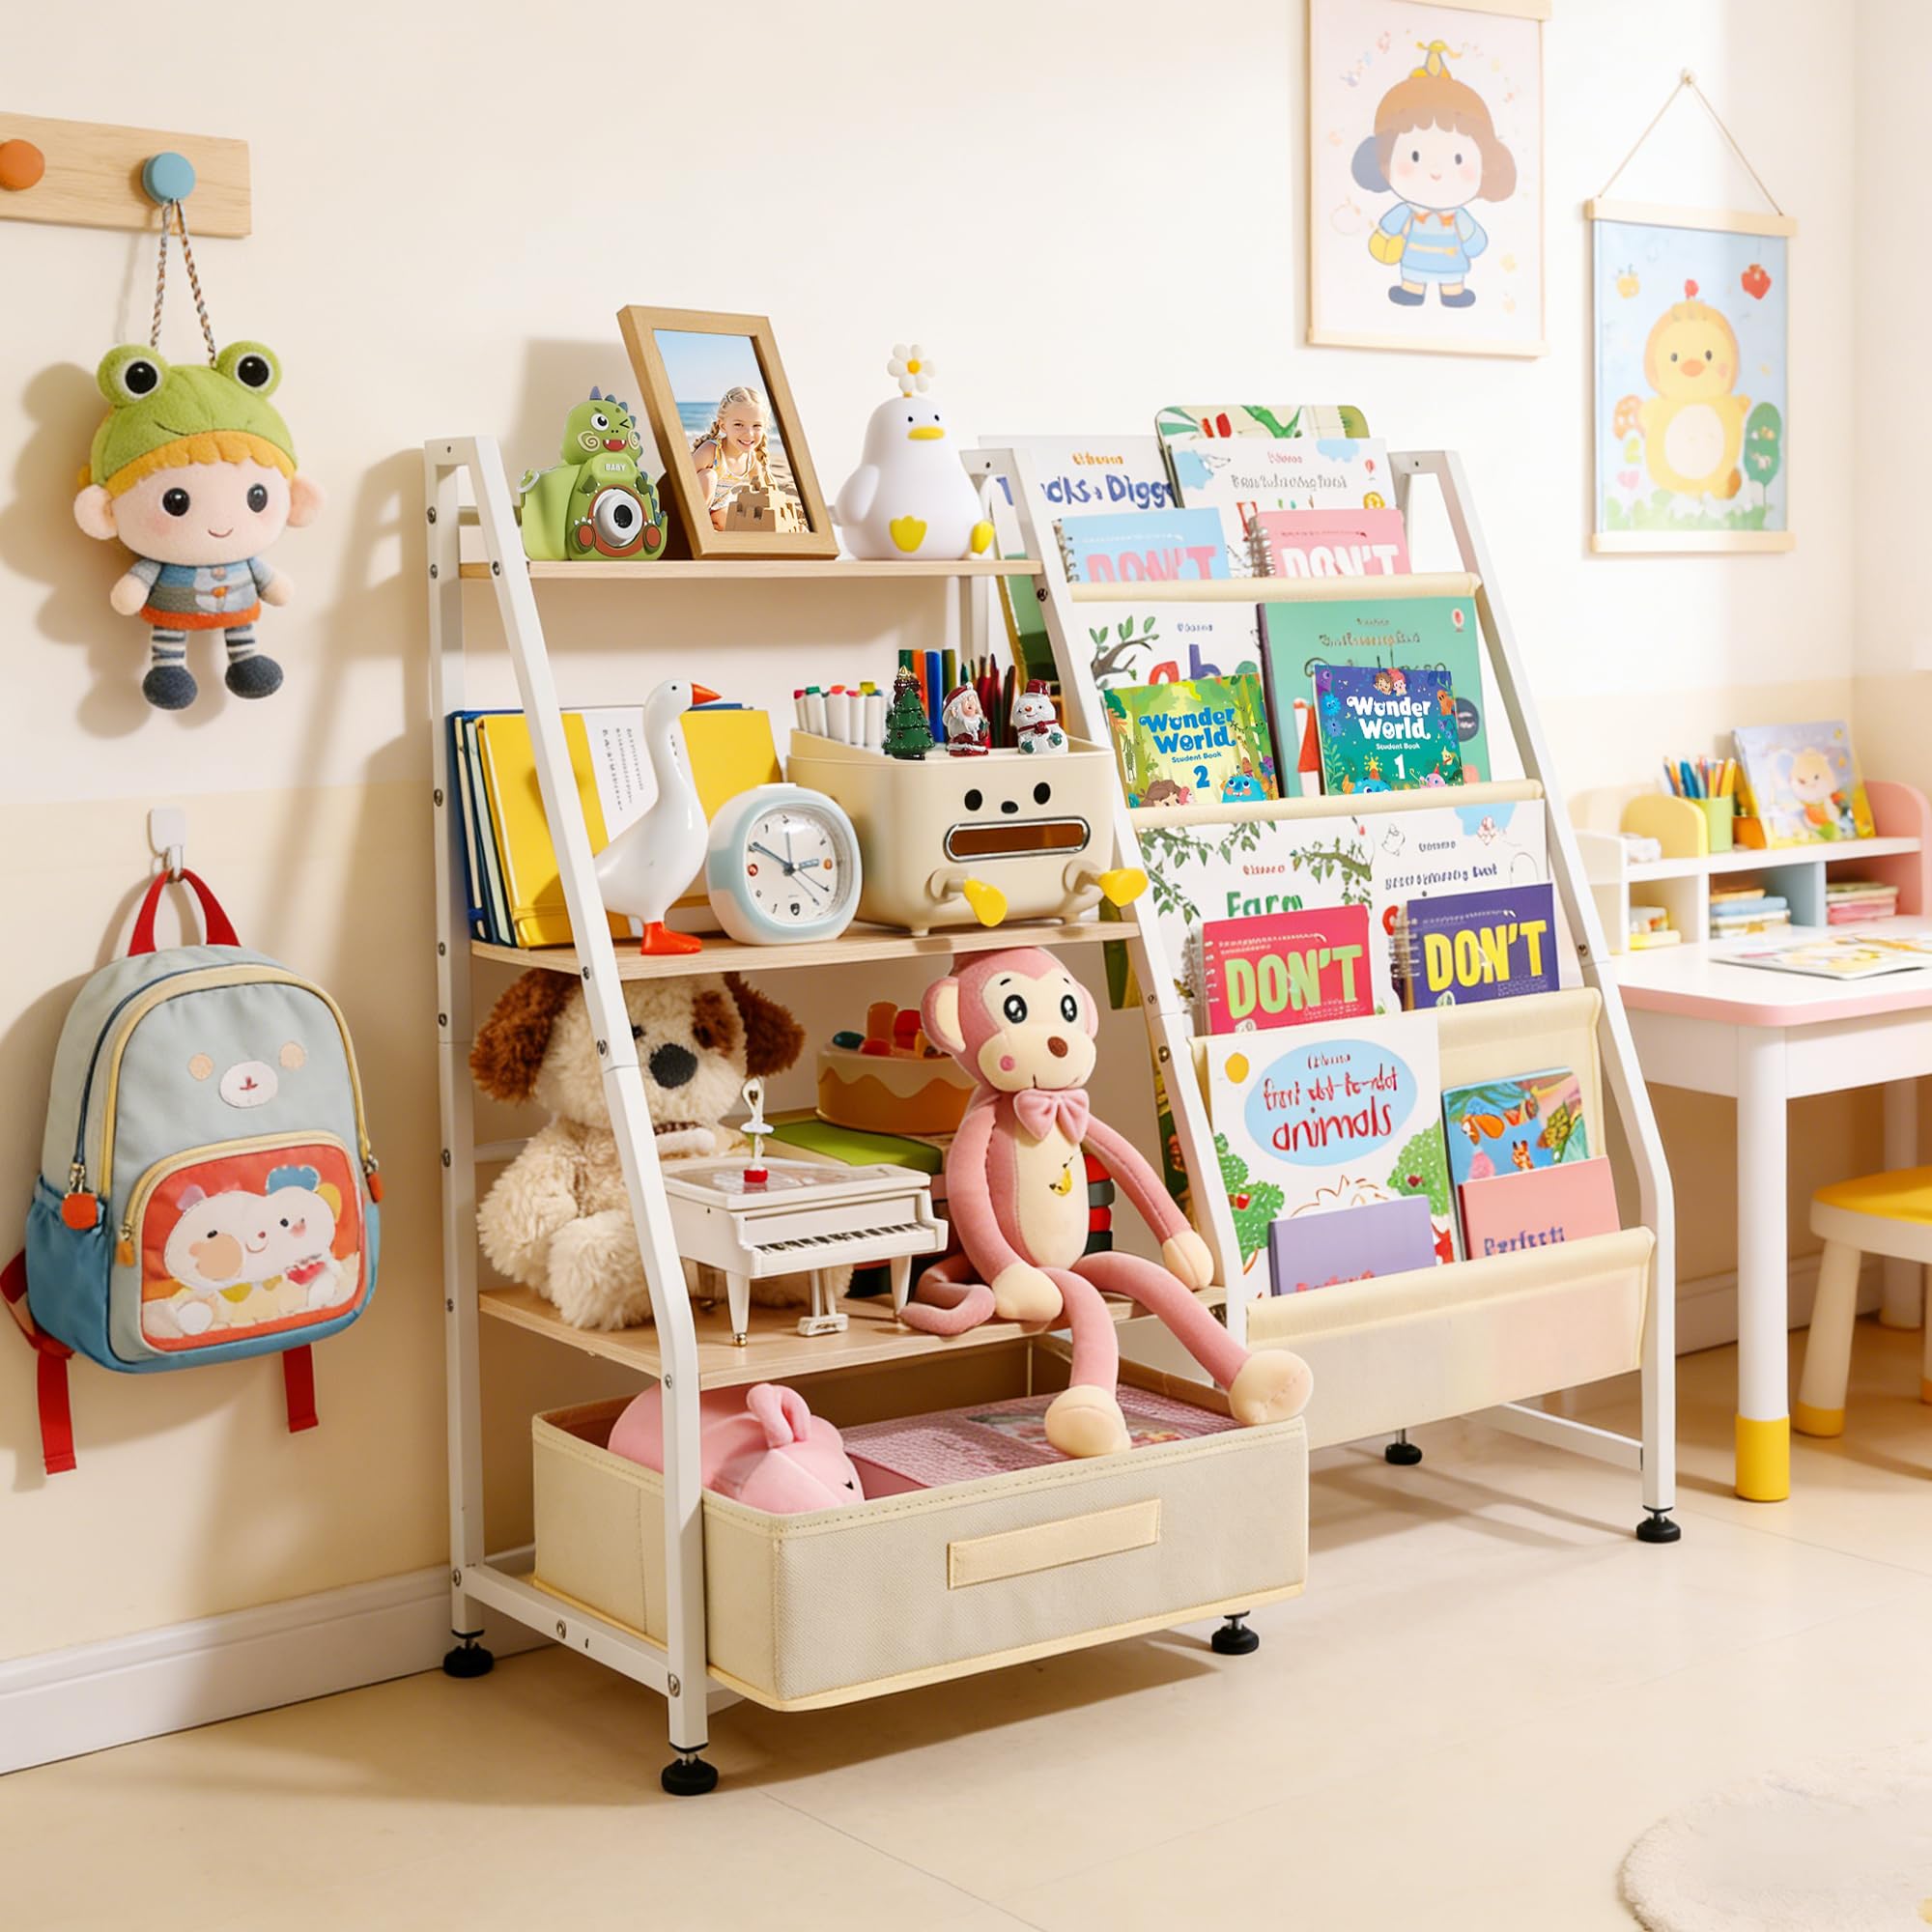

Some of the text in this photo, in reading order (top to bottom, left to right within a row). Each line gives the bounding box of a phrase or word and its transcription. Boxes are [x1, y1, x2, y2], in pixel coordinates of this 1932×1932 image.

[605, 463, 626, 471] BABY
[1347, 696, 1432, 716] Wonder
[1138, 706, 1236, 733] Wonder
[1358, 717, 1432, 741] World
[1152, 725, 1237, 754] World
[1376, 742, 1421, 751] Student Book
[1171, 751, 1222, 764] Student Book
[1394, 753, 1406, 780] 1
[1193, 764, 1210, 789] 2
[1423, 919, 1548, 993] DON'T
[1224, 944, 1363, 1020] DON'T
[1271, 1094, 1392, 1152] animals
